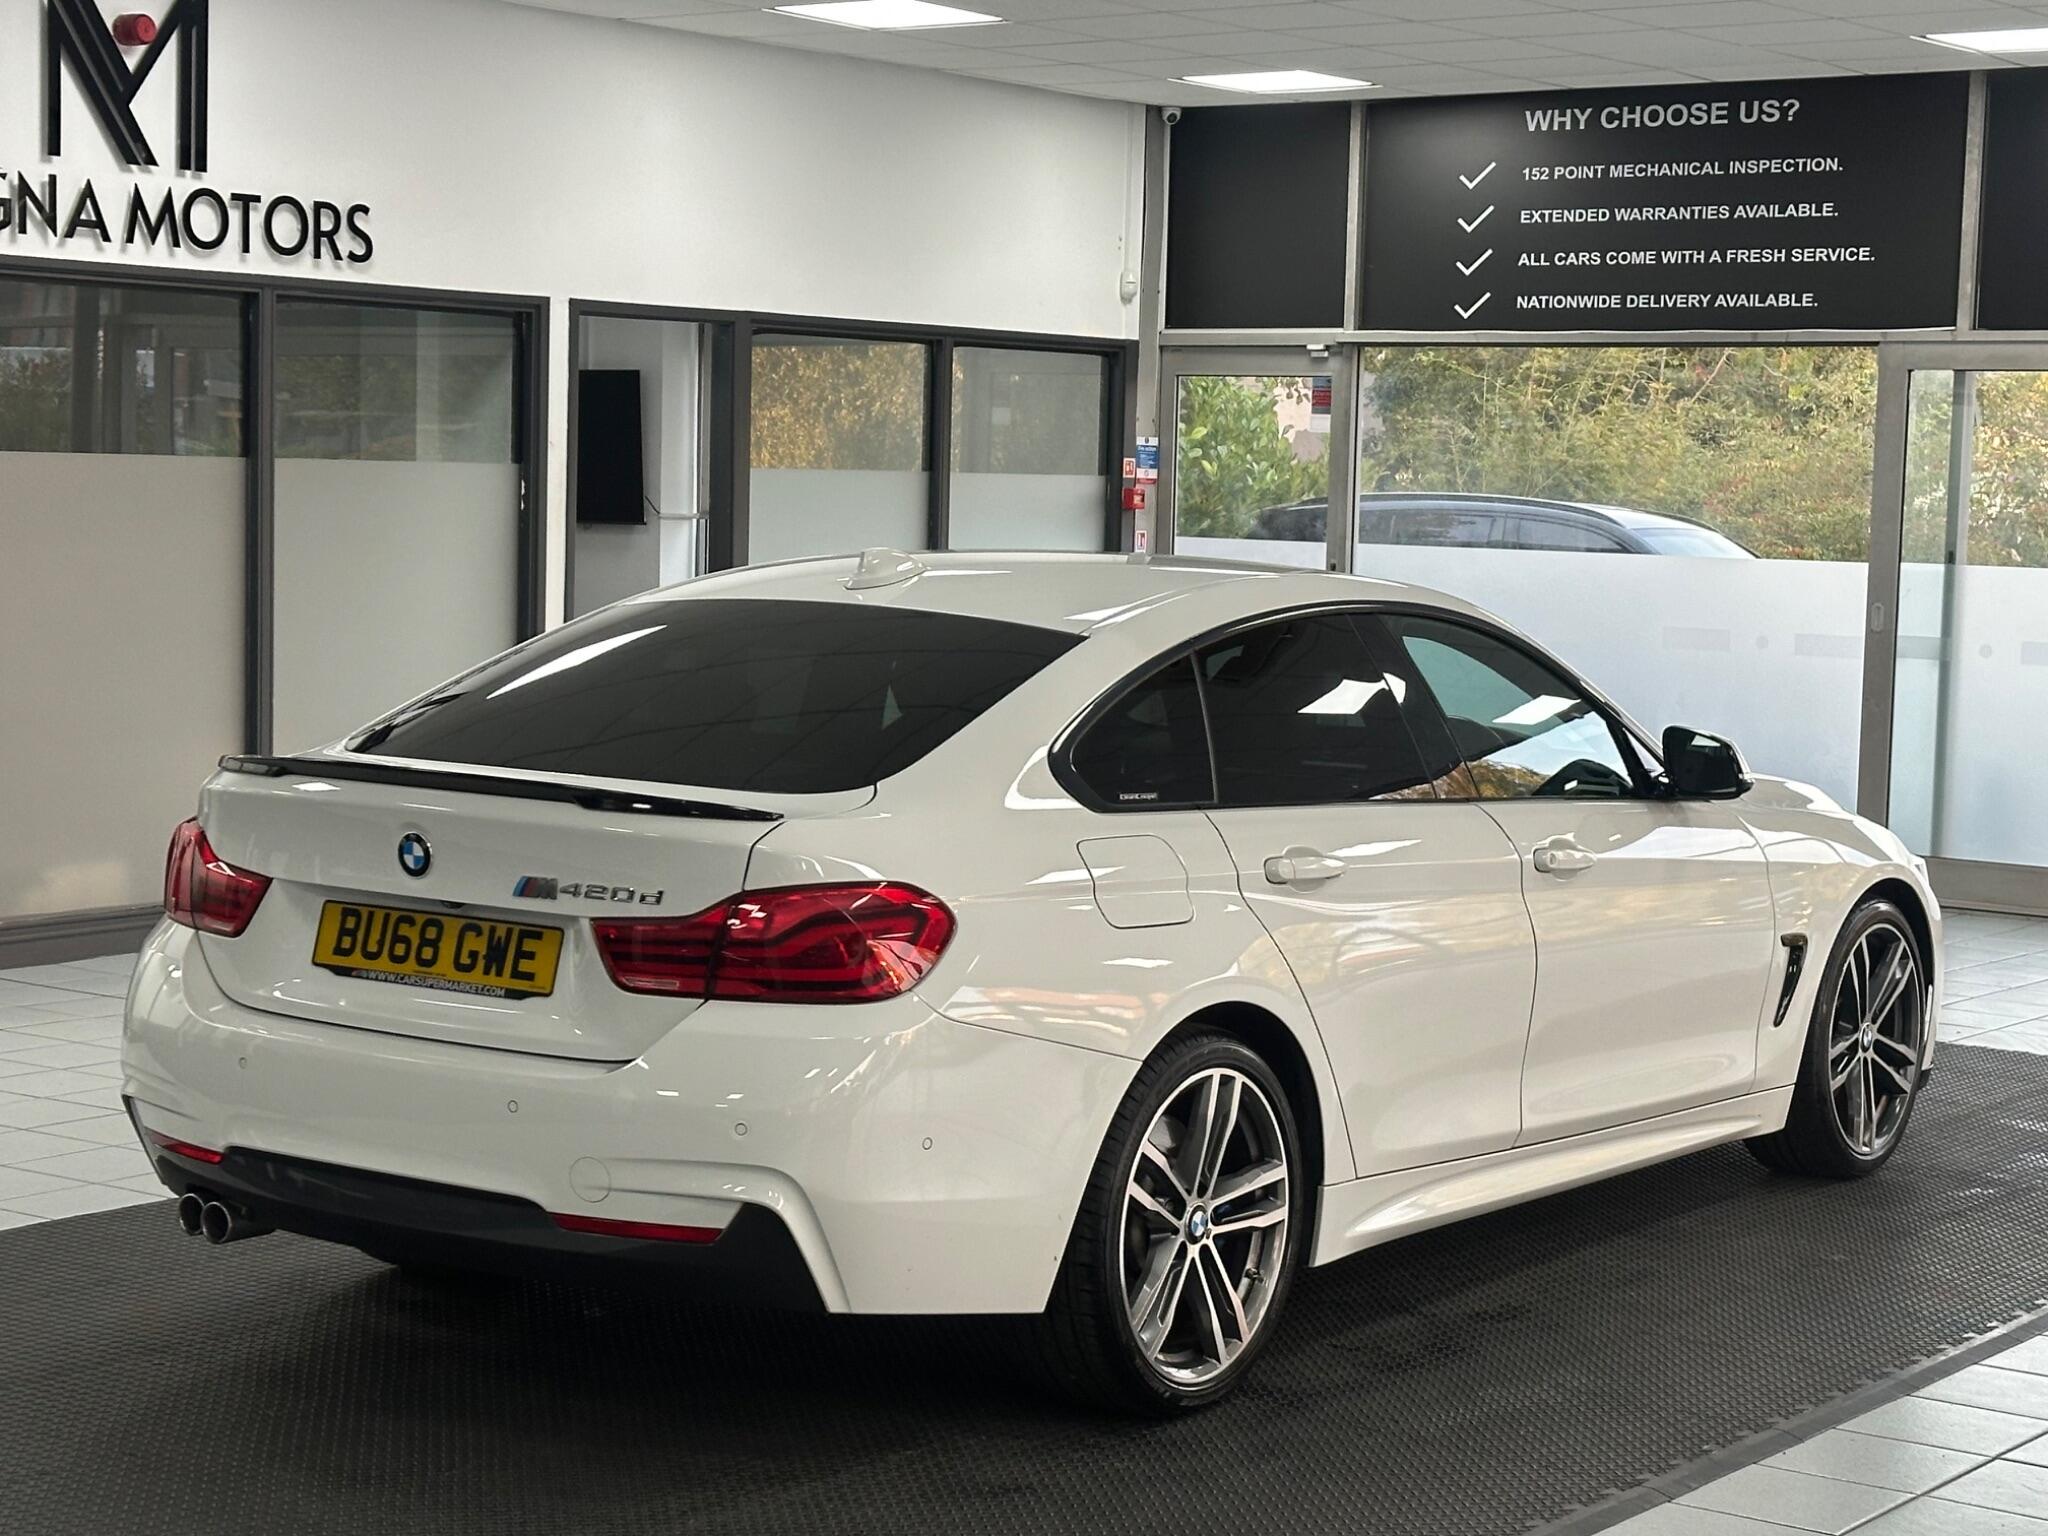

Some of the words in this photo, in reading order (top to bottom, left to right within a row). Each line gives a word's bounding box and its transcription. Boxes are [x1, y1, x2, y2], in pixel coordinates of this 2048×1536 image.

[1525, 108, 1593, 132] WHY
[1600, 101, 1729, 129] CHOOSE
[1739, 99, 1800, 124] US?
[1522, 167, 1549, 181] 152
[1553, 165, 1605, 180] POINT
[1609, 161, 1724, 178] MECHANICAL
[1729, 157, 1844, 174] INSPECTION.
[125, 183, 374, 264] MOTORS
[1520, 208, 1610, 224] EXTENDED
[1614, 206, 1730, 221] WARRANTIES
[1733, 203, 1839, 219] AVAILABLE.
[1517, 253, 1550, 266] ALL
[1554, 252, 1601, 266] CARS
[1605, 251, 1657, 265] COME
[1661, 249, 1705, 264] WITH
[1709, 250, 1722, 263] A
[1726, 249, 1786, 263] FRESH
[1791, 247, 1876, 262] SERVICE.
[1516, 295, 1622, 309] NATIONWIDE
[1626, 294, 1711, 308] DELIVERY
[1714, 293, 1819, 308] AVAILABLE.
[332, 906, 444, 969] BU68
[453, 922, 544, 982] GWE
[367, 970, 506, 998] WWW.CARSUPERMARKET.COM
